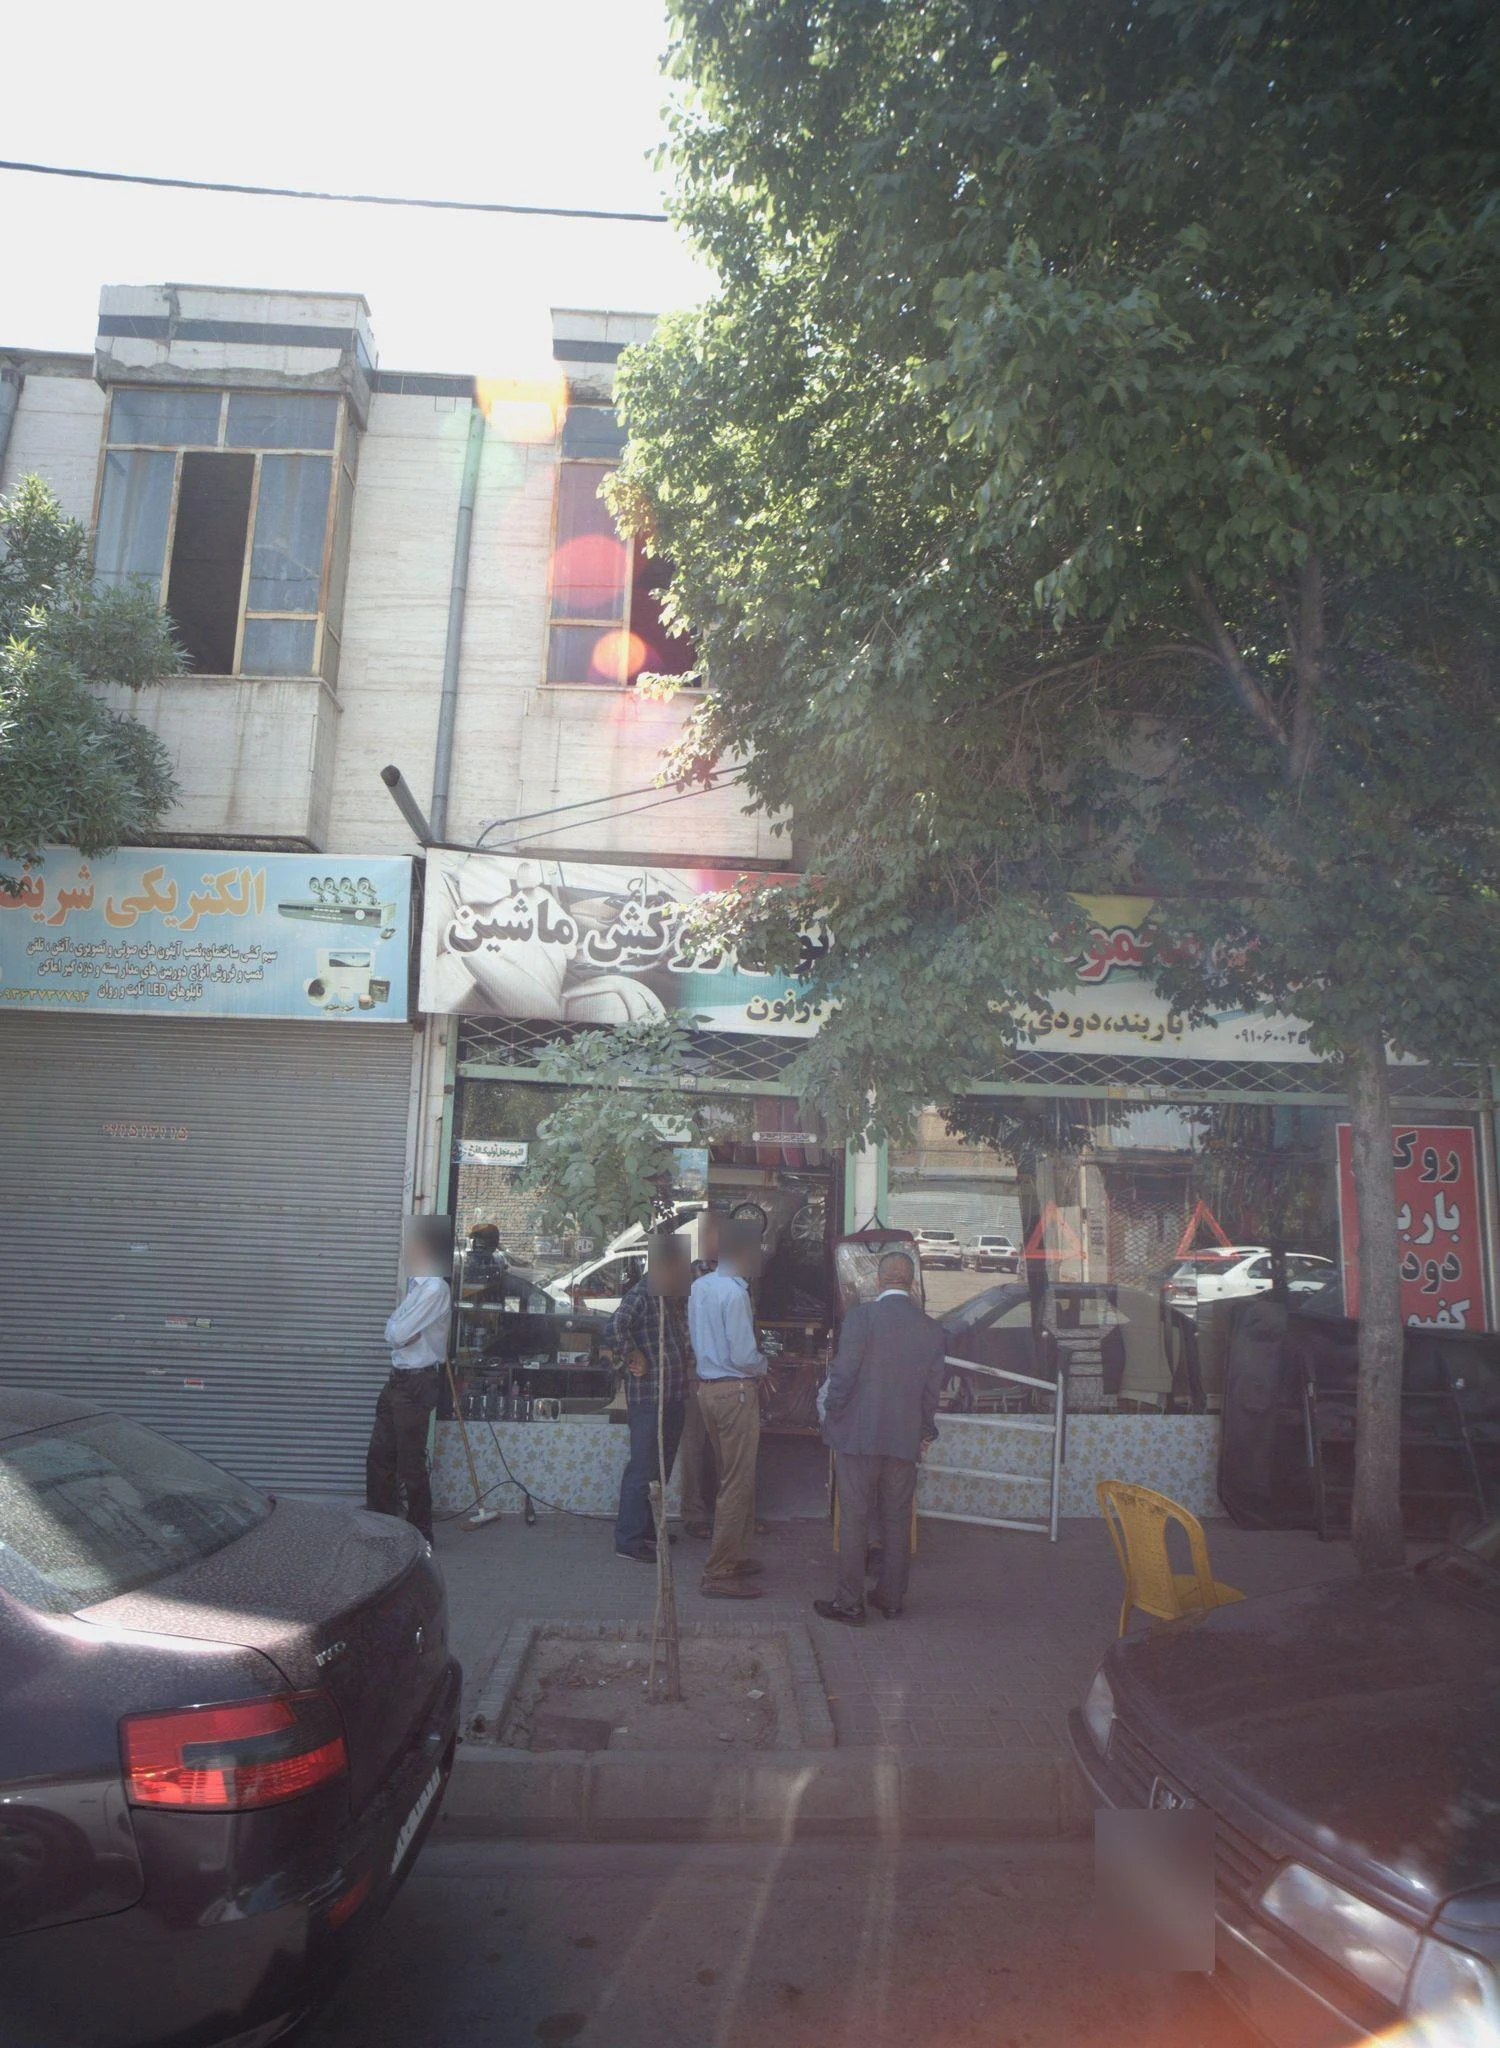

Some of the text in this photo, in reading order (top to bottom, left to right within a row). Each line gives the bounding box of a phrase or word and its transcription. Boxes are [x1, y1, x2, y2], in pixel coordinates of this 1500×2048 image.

[105, 865, 265, 930] الکتریکی
[446, 895, 577, 954] ماشین
[114, 940, 137, 959] صوتی
[139, 941, 156, 959] های
[157, 940, 183, 960] آیفون
[240, 944, 261, 963] کشی
[262, 949, 277, 964] سیم
[38, 958, 61, 976] اماکن
[101, 962, 119, 978] بسته
[120, 961, 138, 979] مدار
[141, 961, 157, 979] های
[159, 964, 187, 981] دوربین
[189, 963, 210, 982] انواع
[211, 963, 236, 982] فروش
[244, 965, 263, 982] نصب
[97, 980, 118, 999] روان
[126, 981, 144, 999] ثابت
[147, 983, 167, 996] LED
[1393, 1131, 1460, 1183] روک
[1398, 1190, 1460, 1244] بارب
[1401, 1251, 1461, 1294] دود
